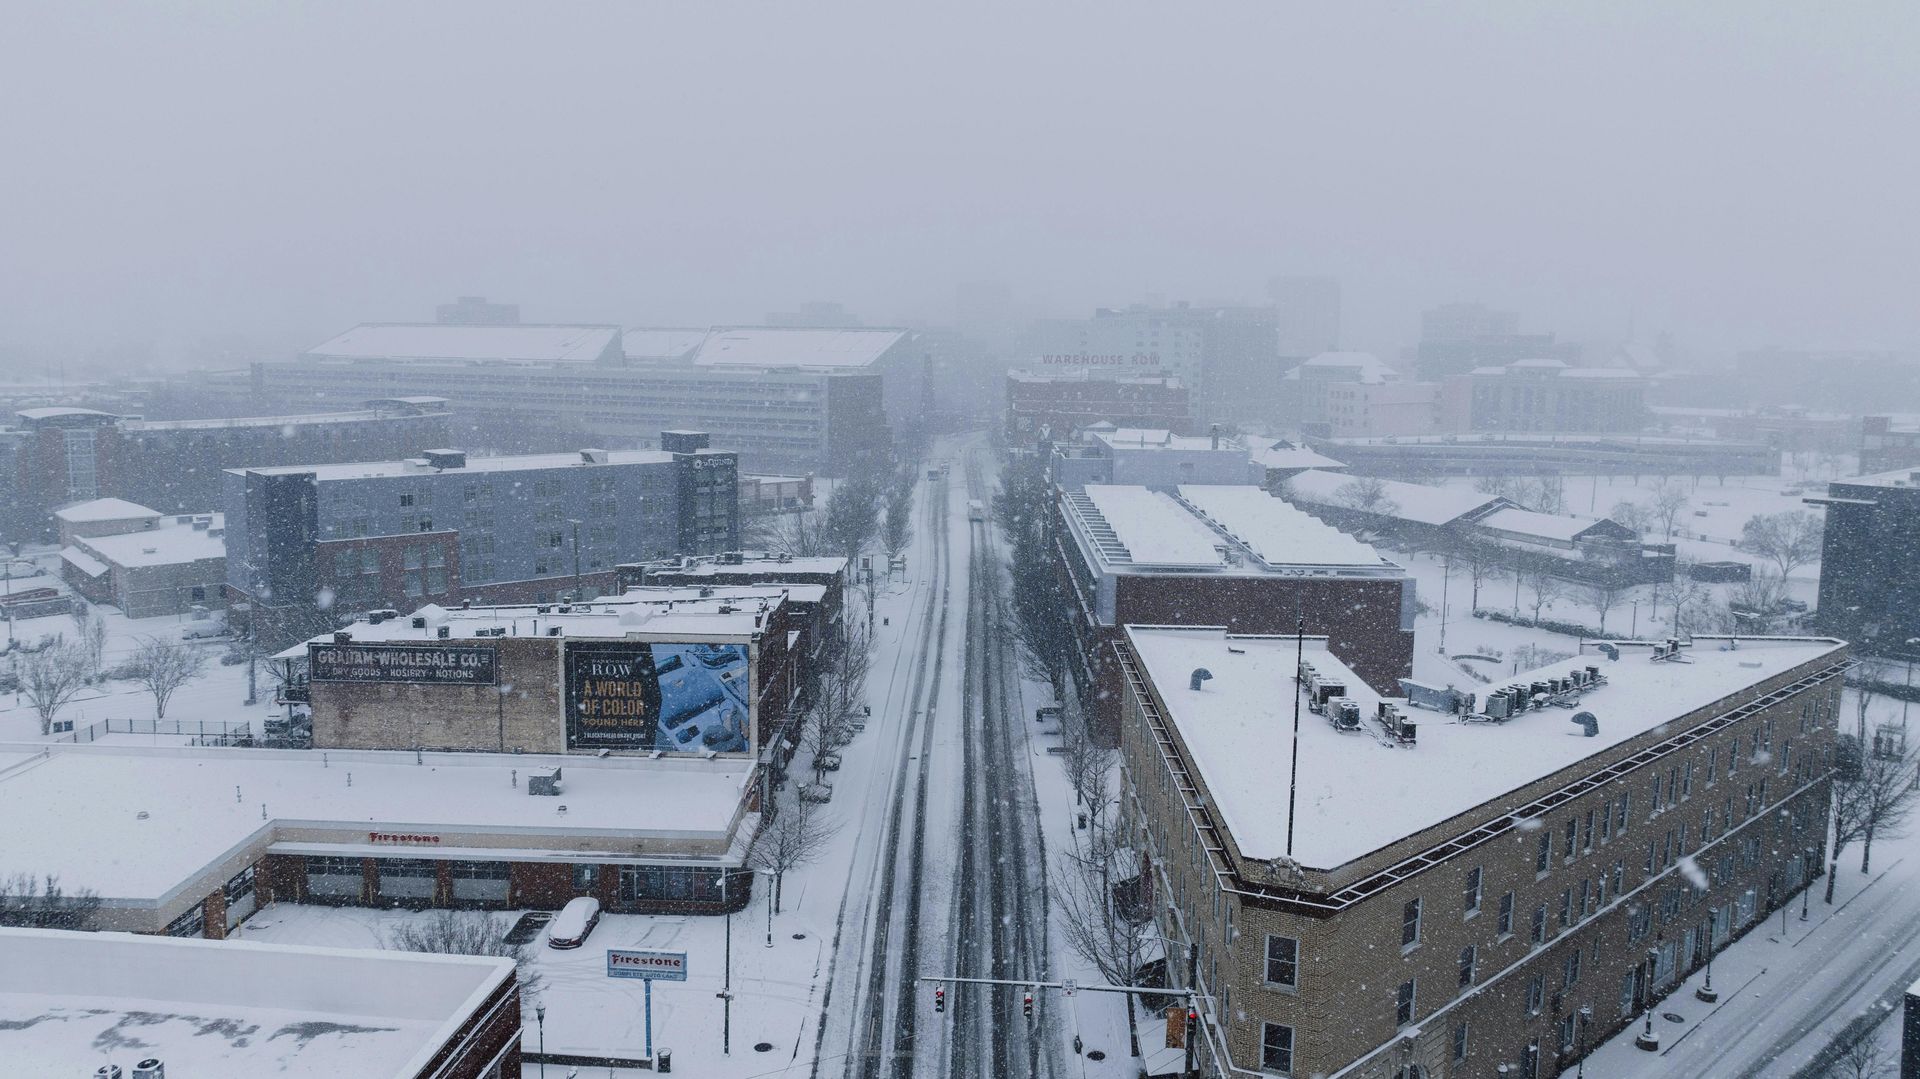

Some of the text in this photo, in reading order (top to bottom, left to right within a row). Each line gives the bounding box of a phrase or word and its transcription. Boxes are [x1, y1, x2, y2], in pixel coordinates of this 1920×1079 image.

[1042, 354, 1161, 365] WAREHOUSE ROW
[379, 652, 456, 667] WHOLESALE
[460, 653, 482, 667] CO.
[332, 667, 474, 679] DRY GOODS HOSIERY NOTIONS
[592, 664, 631, 675] ROW
[584, 680, 642, 697] A WORLD
[583, 699, 644, 716] OF COLOR
[581, 718, 644, 727] FOUND HERE
[369, 832, 440, 843] Firestone
[612, 953, 681, 967] Firestone
